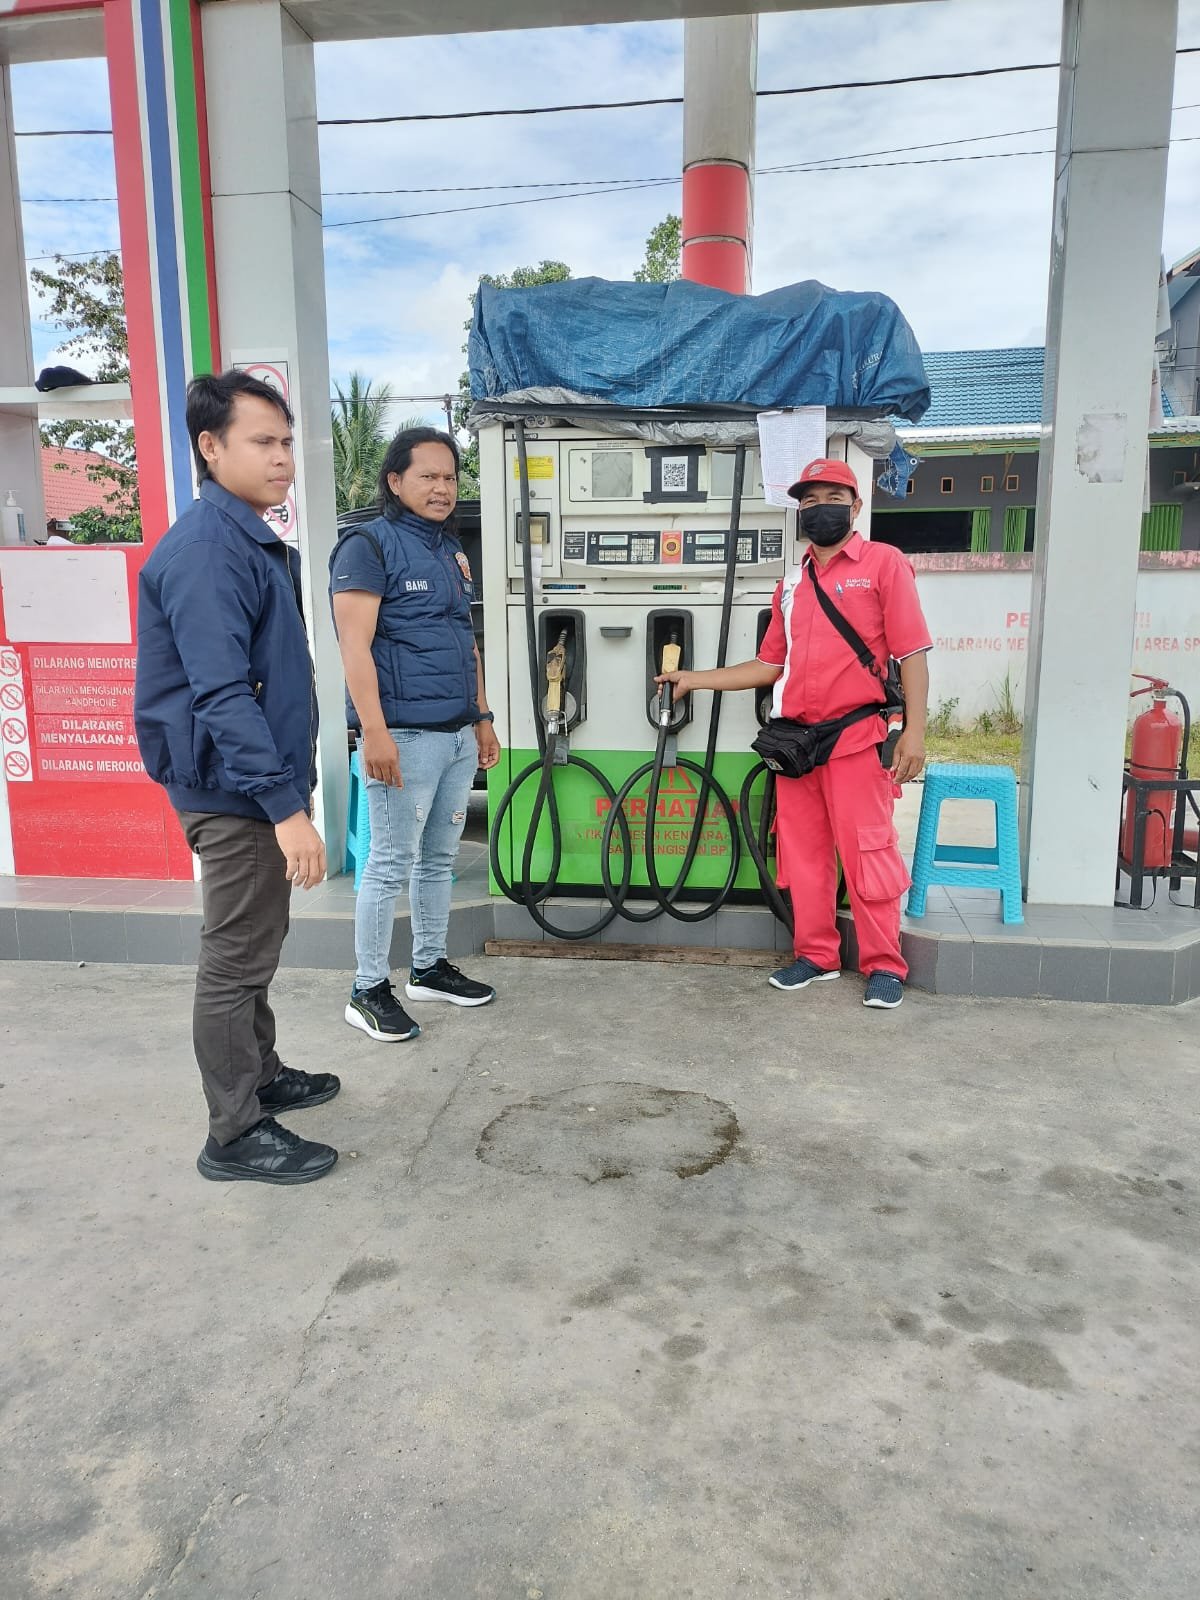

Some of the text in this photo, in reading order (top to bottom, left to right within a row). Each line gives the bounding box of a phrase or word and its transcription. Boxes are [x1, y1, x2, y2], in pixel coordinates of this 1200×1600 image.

[937, 637, 1002, 651] DILARANG
[1007, 637, 1025, 651] ME
[1144, 637, 1179, 651] AREA
[1184, 637, 1200, 651] SP
[33, 657, 136, 669] DILARANG MEMOTRE
[80, 686, 135, 696] MENGGUNAK
[62, 719, 124, 731] DILARANG
[40, 733, 123, 745] MENYALAKAN
[42, 759, 93, 771] DILARANG
[595, 797, 740, 818] PRHATA
[630, 830, 660, 841] ESN
[608, 845, 638, 855] SAT
